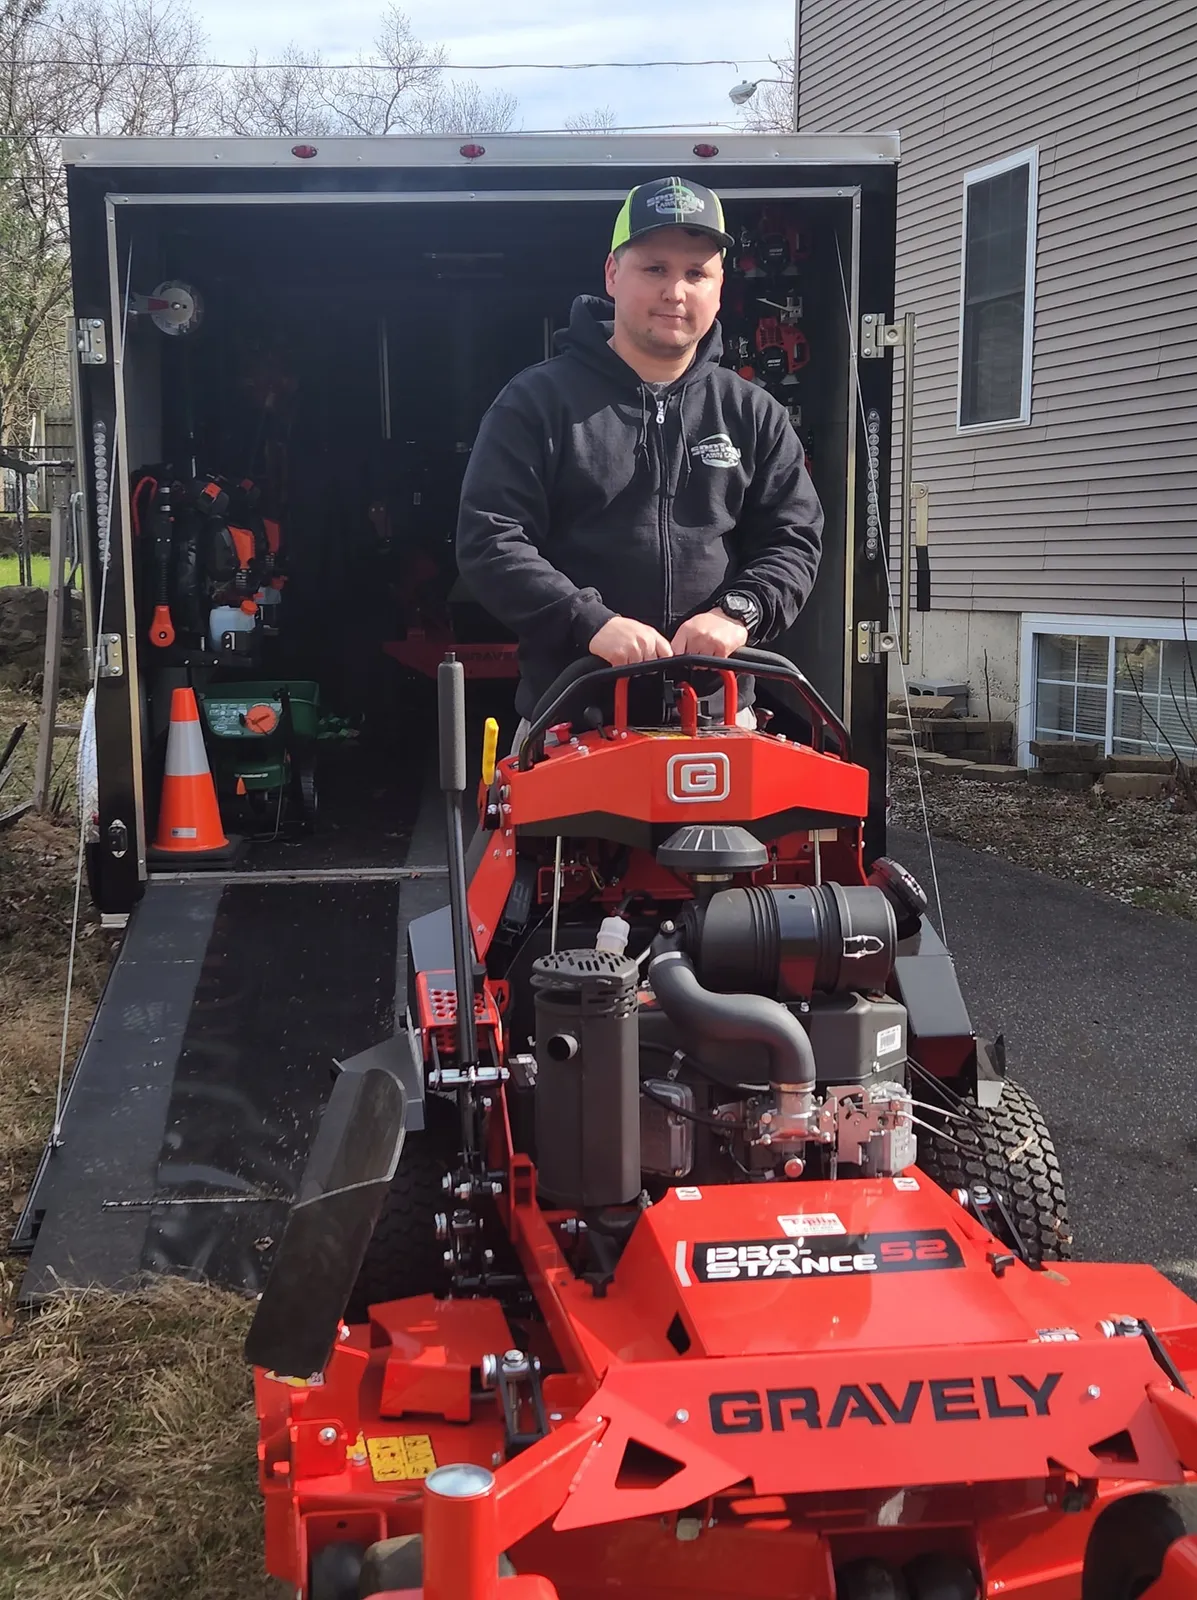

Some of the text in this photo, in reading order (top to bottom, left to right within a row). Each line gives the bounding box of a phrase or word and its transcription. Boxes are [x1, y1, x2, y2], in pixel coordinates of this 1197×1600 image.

[681, 763, 717, 793] G
[705, 1239, 949, 1279] STANCE 52
[708, 1372, 1064, 1435] GRAVELY
